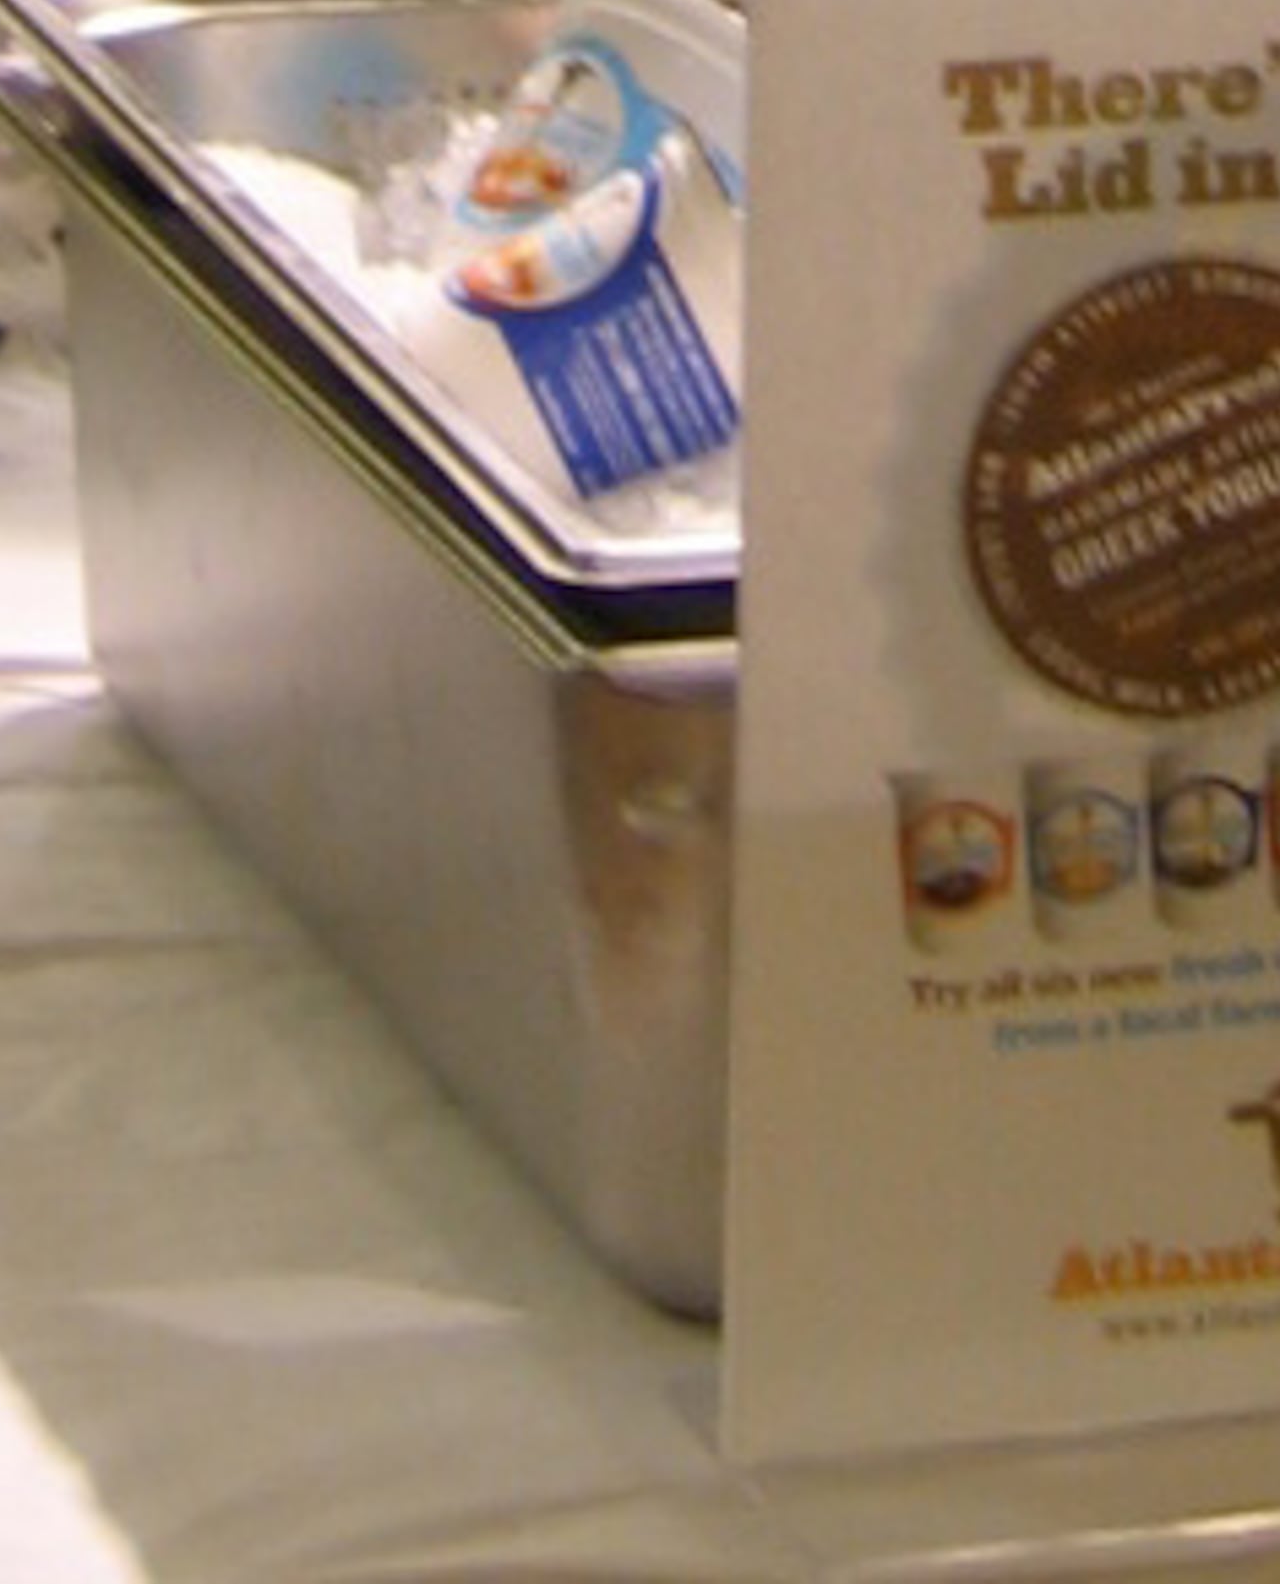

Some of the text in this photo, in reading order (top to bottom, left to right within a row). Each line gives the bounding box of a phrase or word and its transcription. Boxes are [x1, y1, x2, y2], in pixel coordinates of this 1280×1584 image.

[979, 139, 1155, 223] Lid
[1050, 509, 1180, 589] GREEK
[907, 975, 969, 1011] Try
[979, 969, 1022, 1002] all
[994, 1018, 1080, 1052] from
